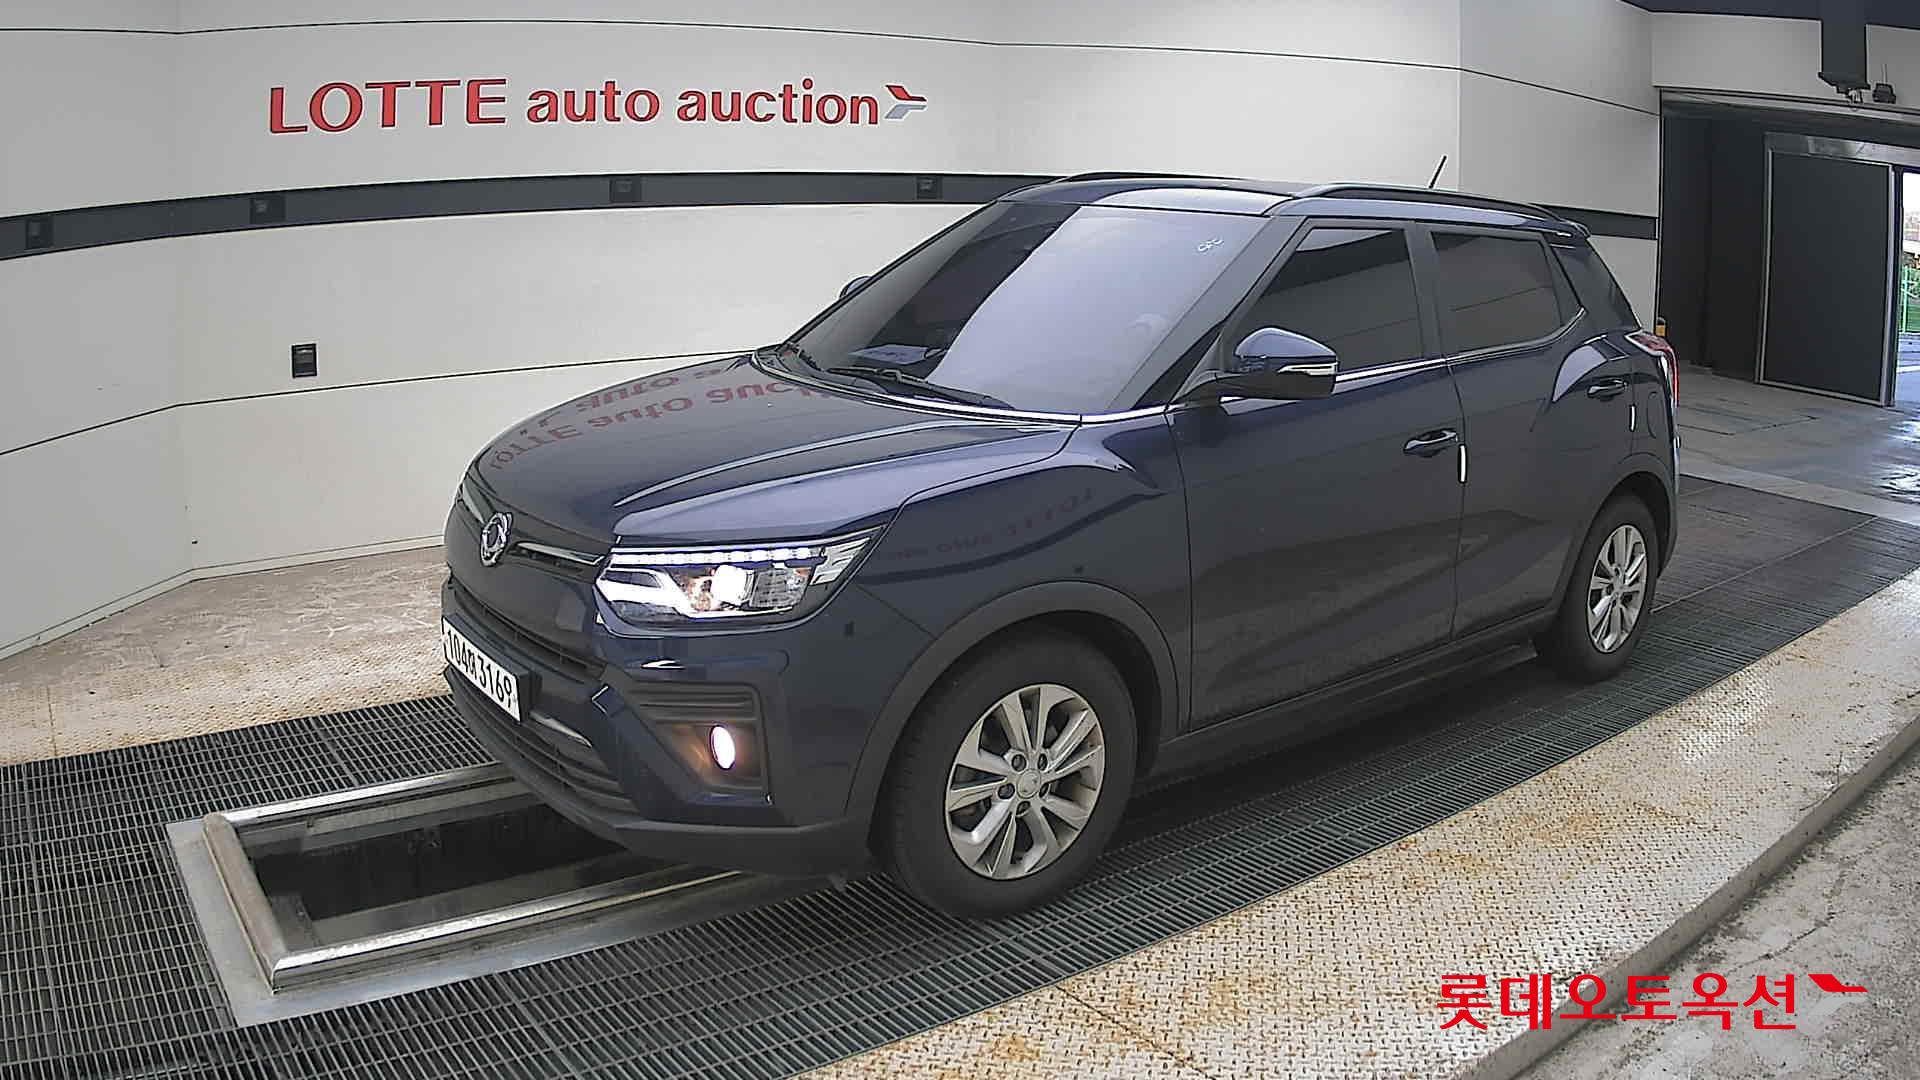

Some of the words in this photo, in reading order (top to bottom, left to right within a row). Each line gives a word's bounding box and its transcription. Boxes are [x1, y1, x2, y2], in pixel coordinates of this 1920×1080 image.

[270, 79, 506, 133] LOTTE
[528, 81, 661, 122] auto
[678, 79, 878, 124] auction
